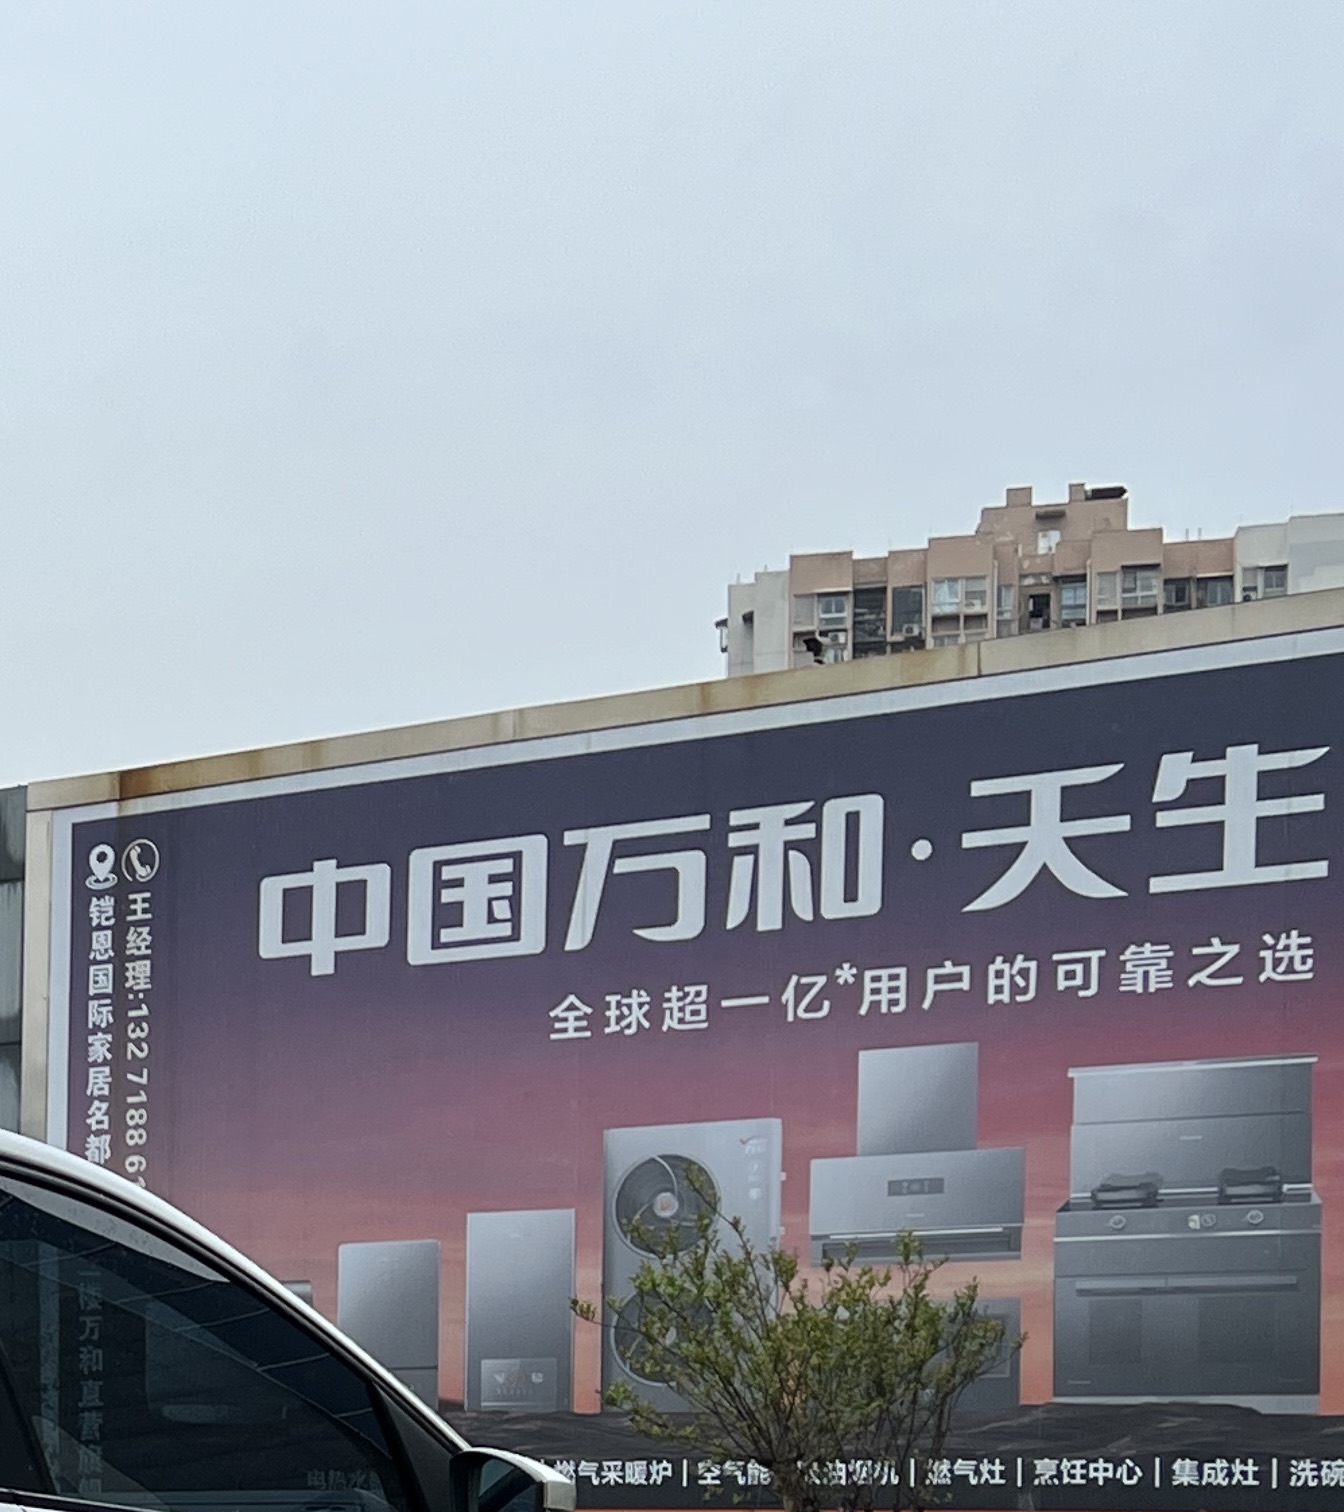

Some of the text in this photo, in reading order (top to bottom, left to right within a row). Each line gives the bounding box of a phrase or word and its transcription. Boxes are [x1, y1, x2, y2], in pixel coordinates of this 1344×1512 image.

[85, 895, 116, 1165] 铠恩国际家居名都
[1033, 1458, 1144, 1486] 烹饪中心
[1171, 1458, 1261, 1487] 集成灶
